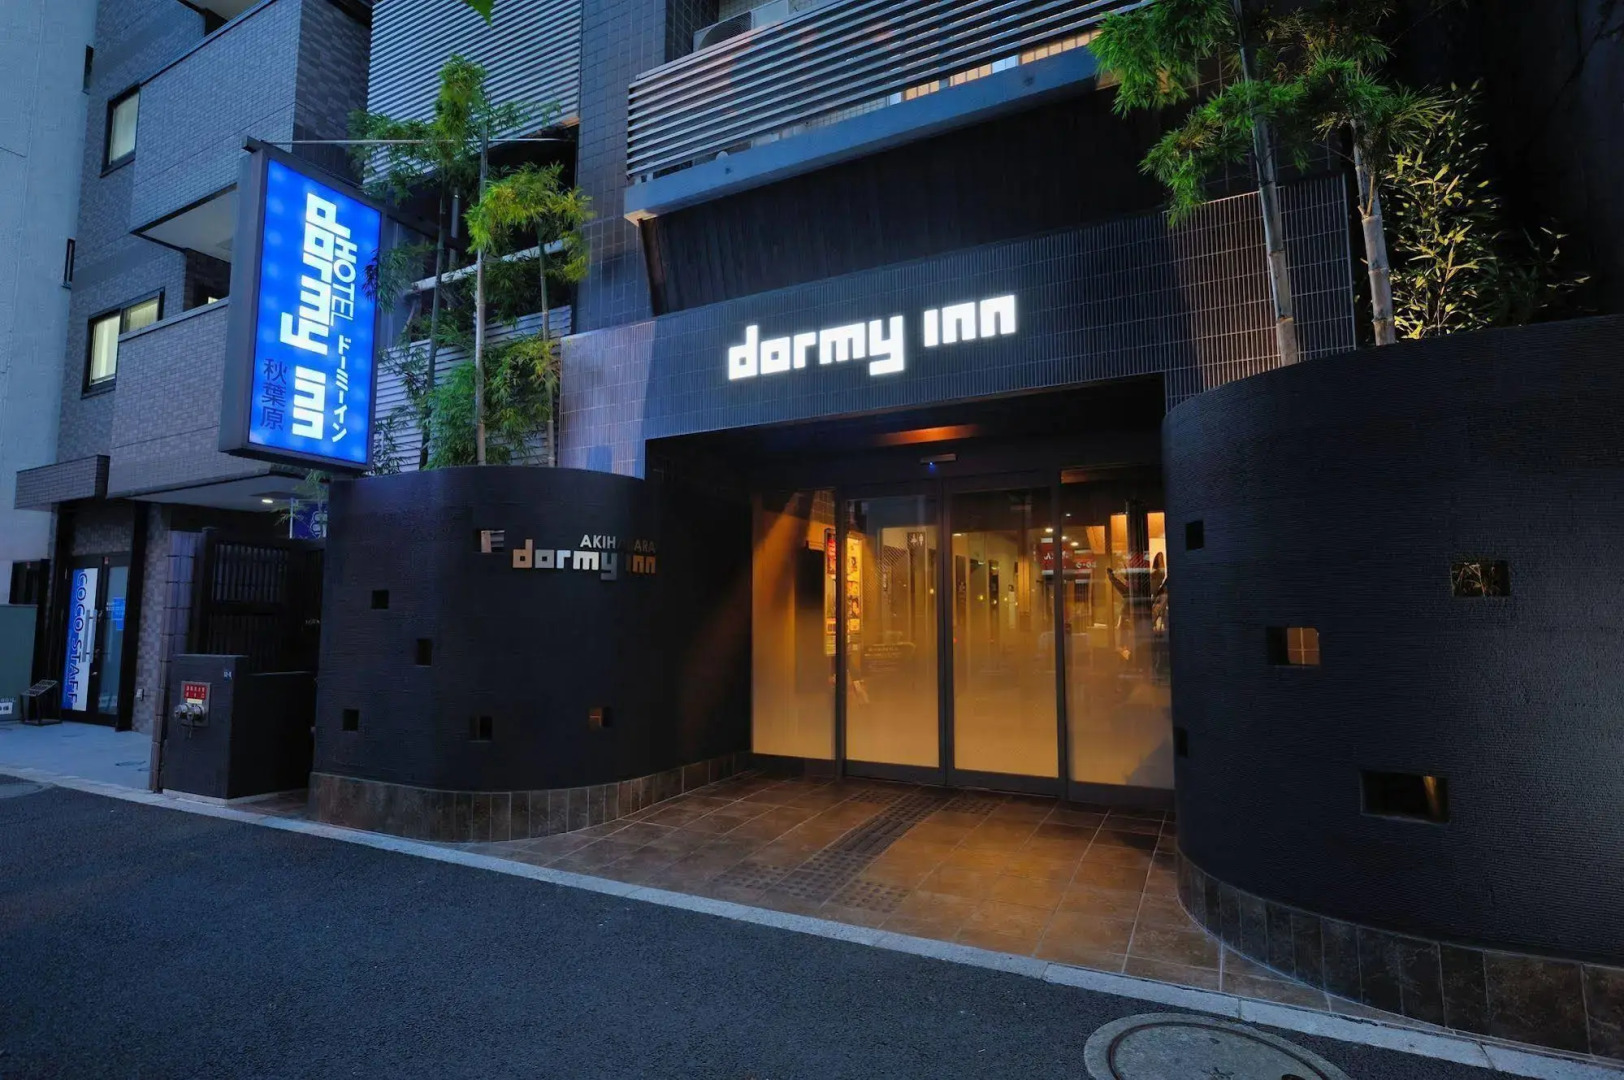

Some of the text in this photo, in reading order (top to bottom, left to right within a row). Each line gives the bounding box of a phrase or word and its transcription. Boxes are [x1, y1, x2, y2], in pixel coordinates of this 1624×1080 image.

[280, 193, 350, 440] dormy inn
[330, 237, 357, 326] HOTEL
[728, 295, 1016, 381] dormy inn
[260, 358, 287, 431] 秋葉原
[332, 335, 351, 442] ドーミーイン
[512, 538, 617, 580] dormy
[73, 573, 88, 633] COCO
[67, 640, 83, 705] STAFF
